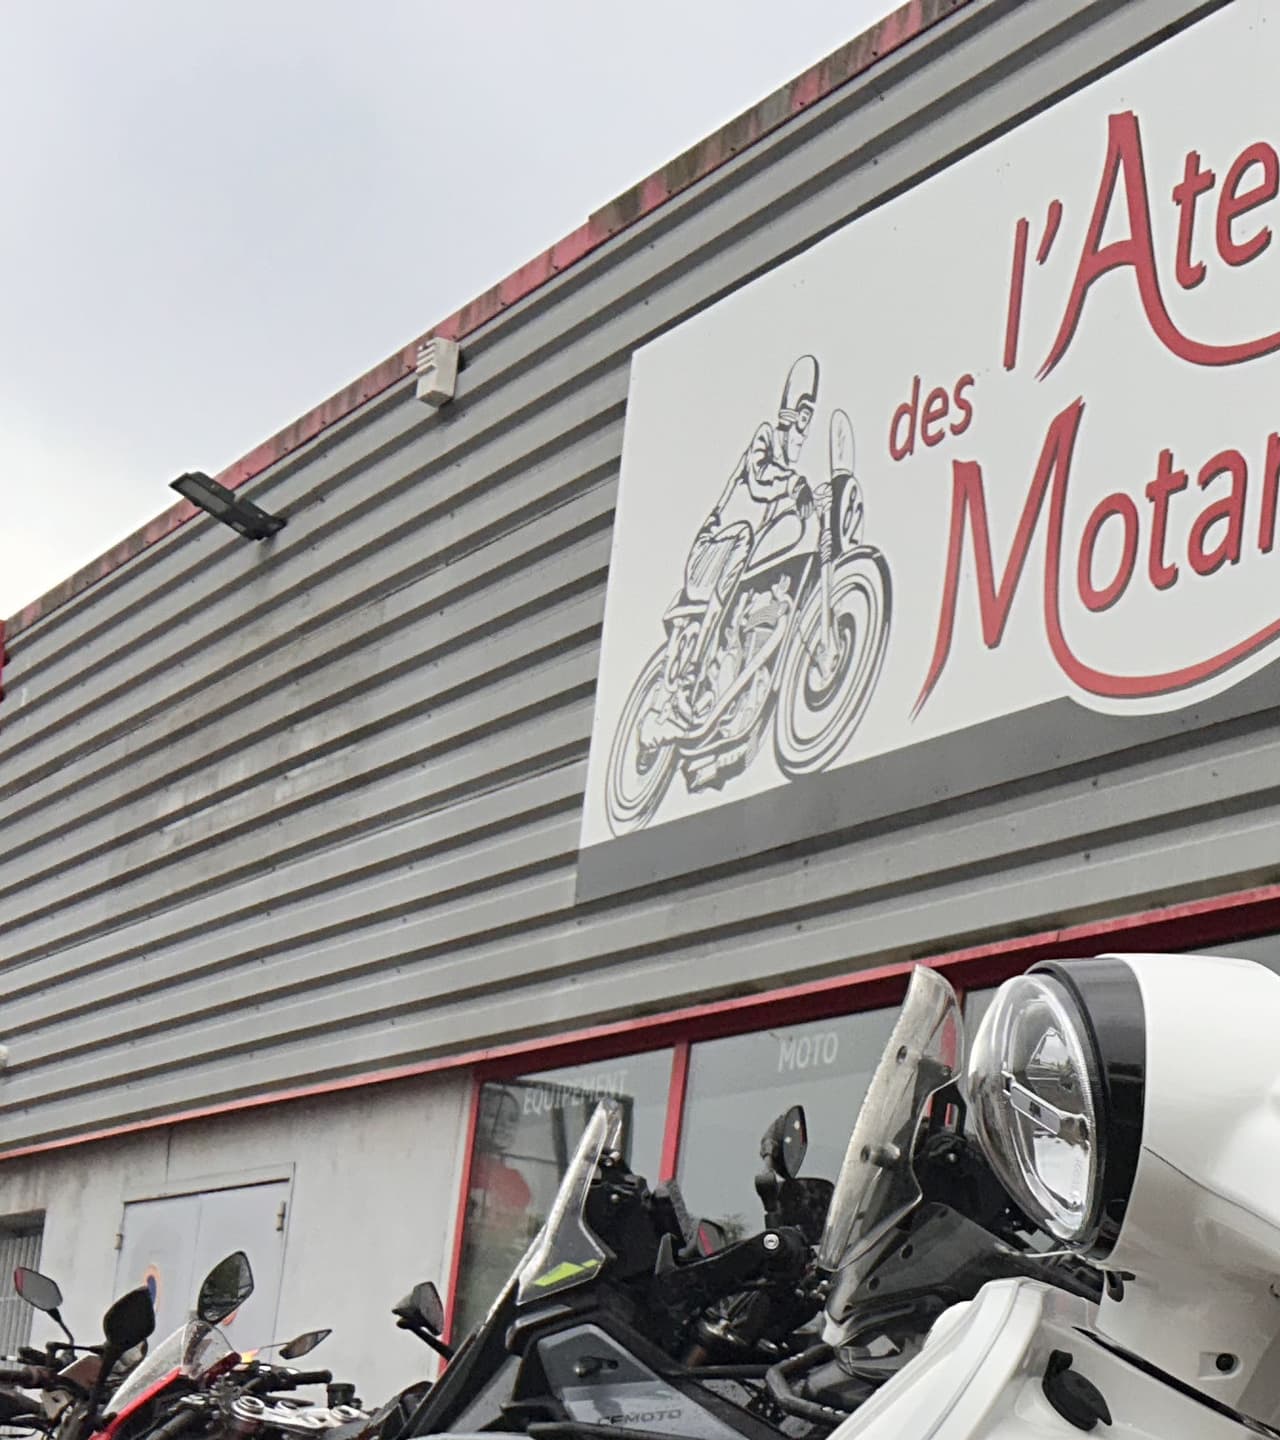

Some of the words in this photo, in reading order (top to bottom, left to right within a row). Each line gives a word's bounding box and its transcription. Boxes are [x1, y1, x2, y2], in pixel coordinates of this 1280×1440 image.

[889, 373, 974, 462] des
[777, 1031, 838, 1073] MOTO
[523, 1069, 628, 1115] EQUIPEMENT
[597, 1408, 682, 1425] CFMOTO
